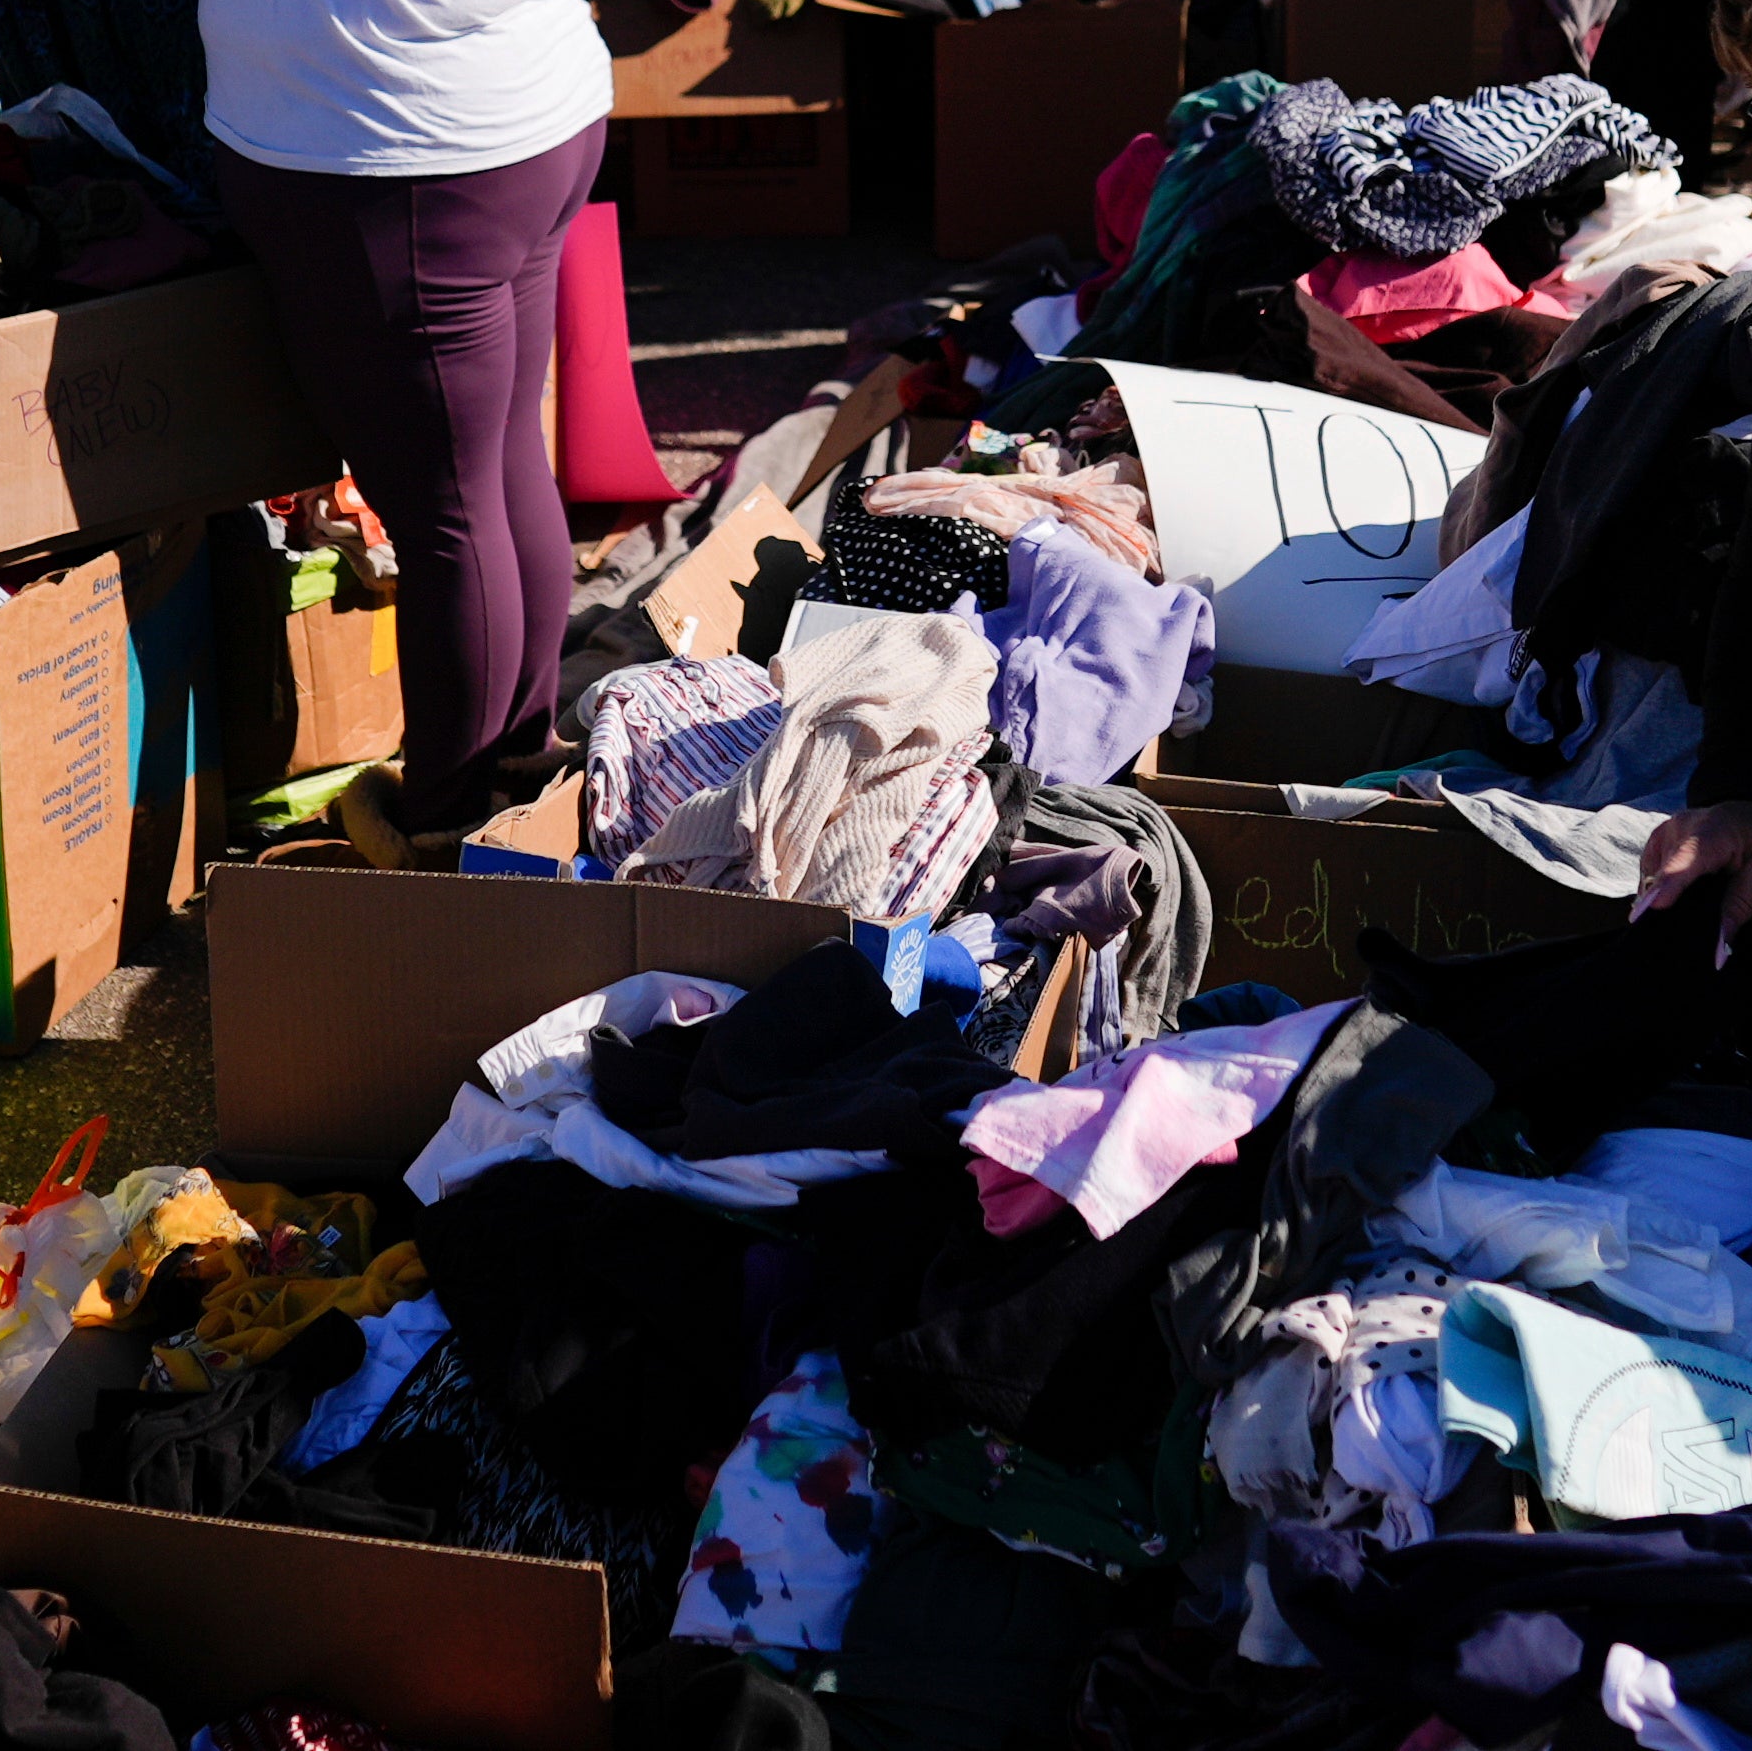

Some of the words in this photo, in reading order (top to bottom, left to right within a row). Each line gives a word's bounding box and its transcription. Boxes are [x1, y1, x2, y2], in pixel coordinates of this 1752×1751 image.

[11, 359, 124, 438] BABY
[92, 573, 122, 596] ving
[52, 655, 63, 668] of
[66, 639, 90, 659] Load
[17, 662, 51, 684] Bricks
[62, 654, 99, 682] Garage
[59, 672, 100, 704] Laundry
[77, 690, 99, 710] Attic
[52, 709, 100, 745] Basement
[78, 728, 100, 748] Bath
[66, 746, 101, 774] Kitchen
[73, 763, 101, 789] Dining
[42, 784, 73, 807] Room
[73, 781, 101, 807] Family
[42, 802, 73, 826] Room
[61, 799, 102, 834] Bedroom
[64, 817, 103, 854] FRAGILE
